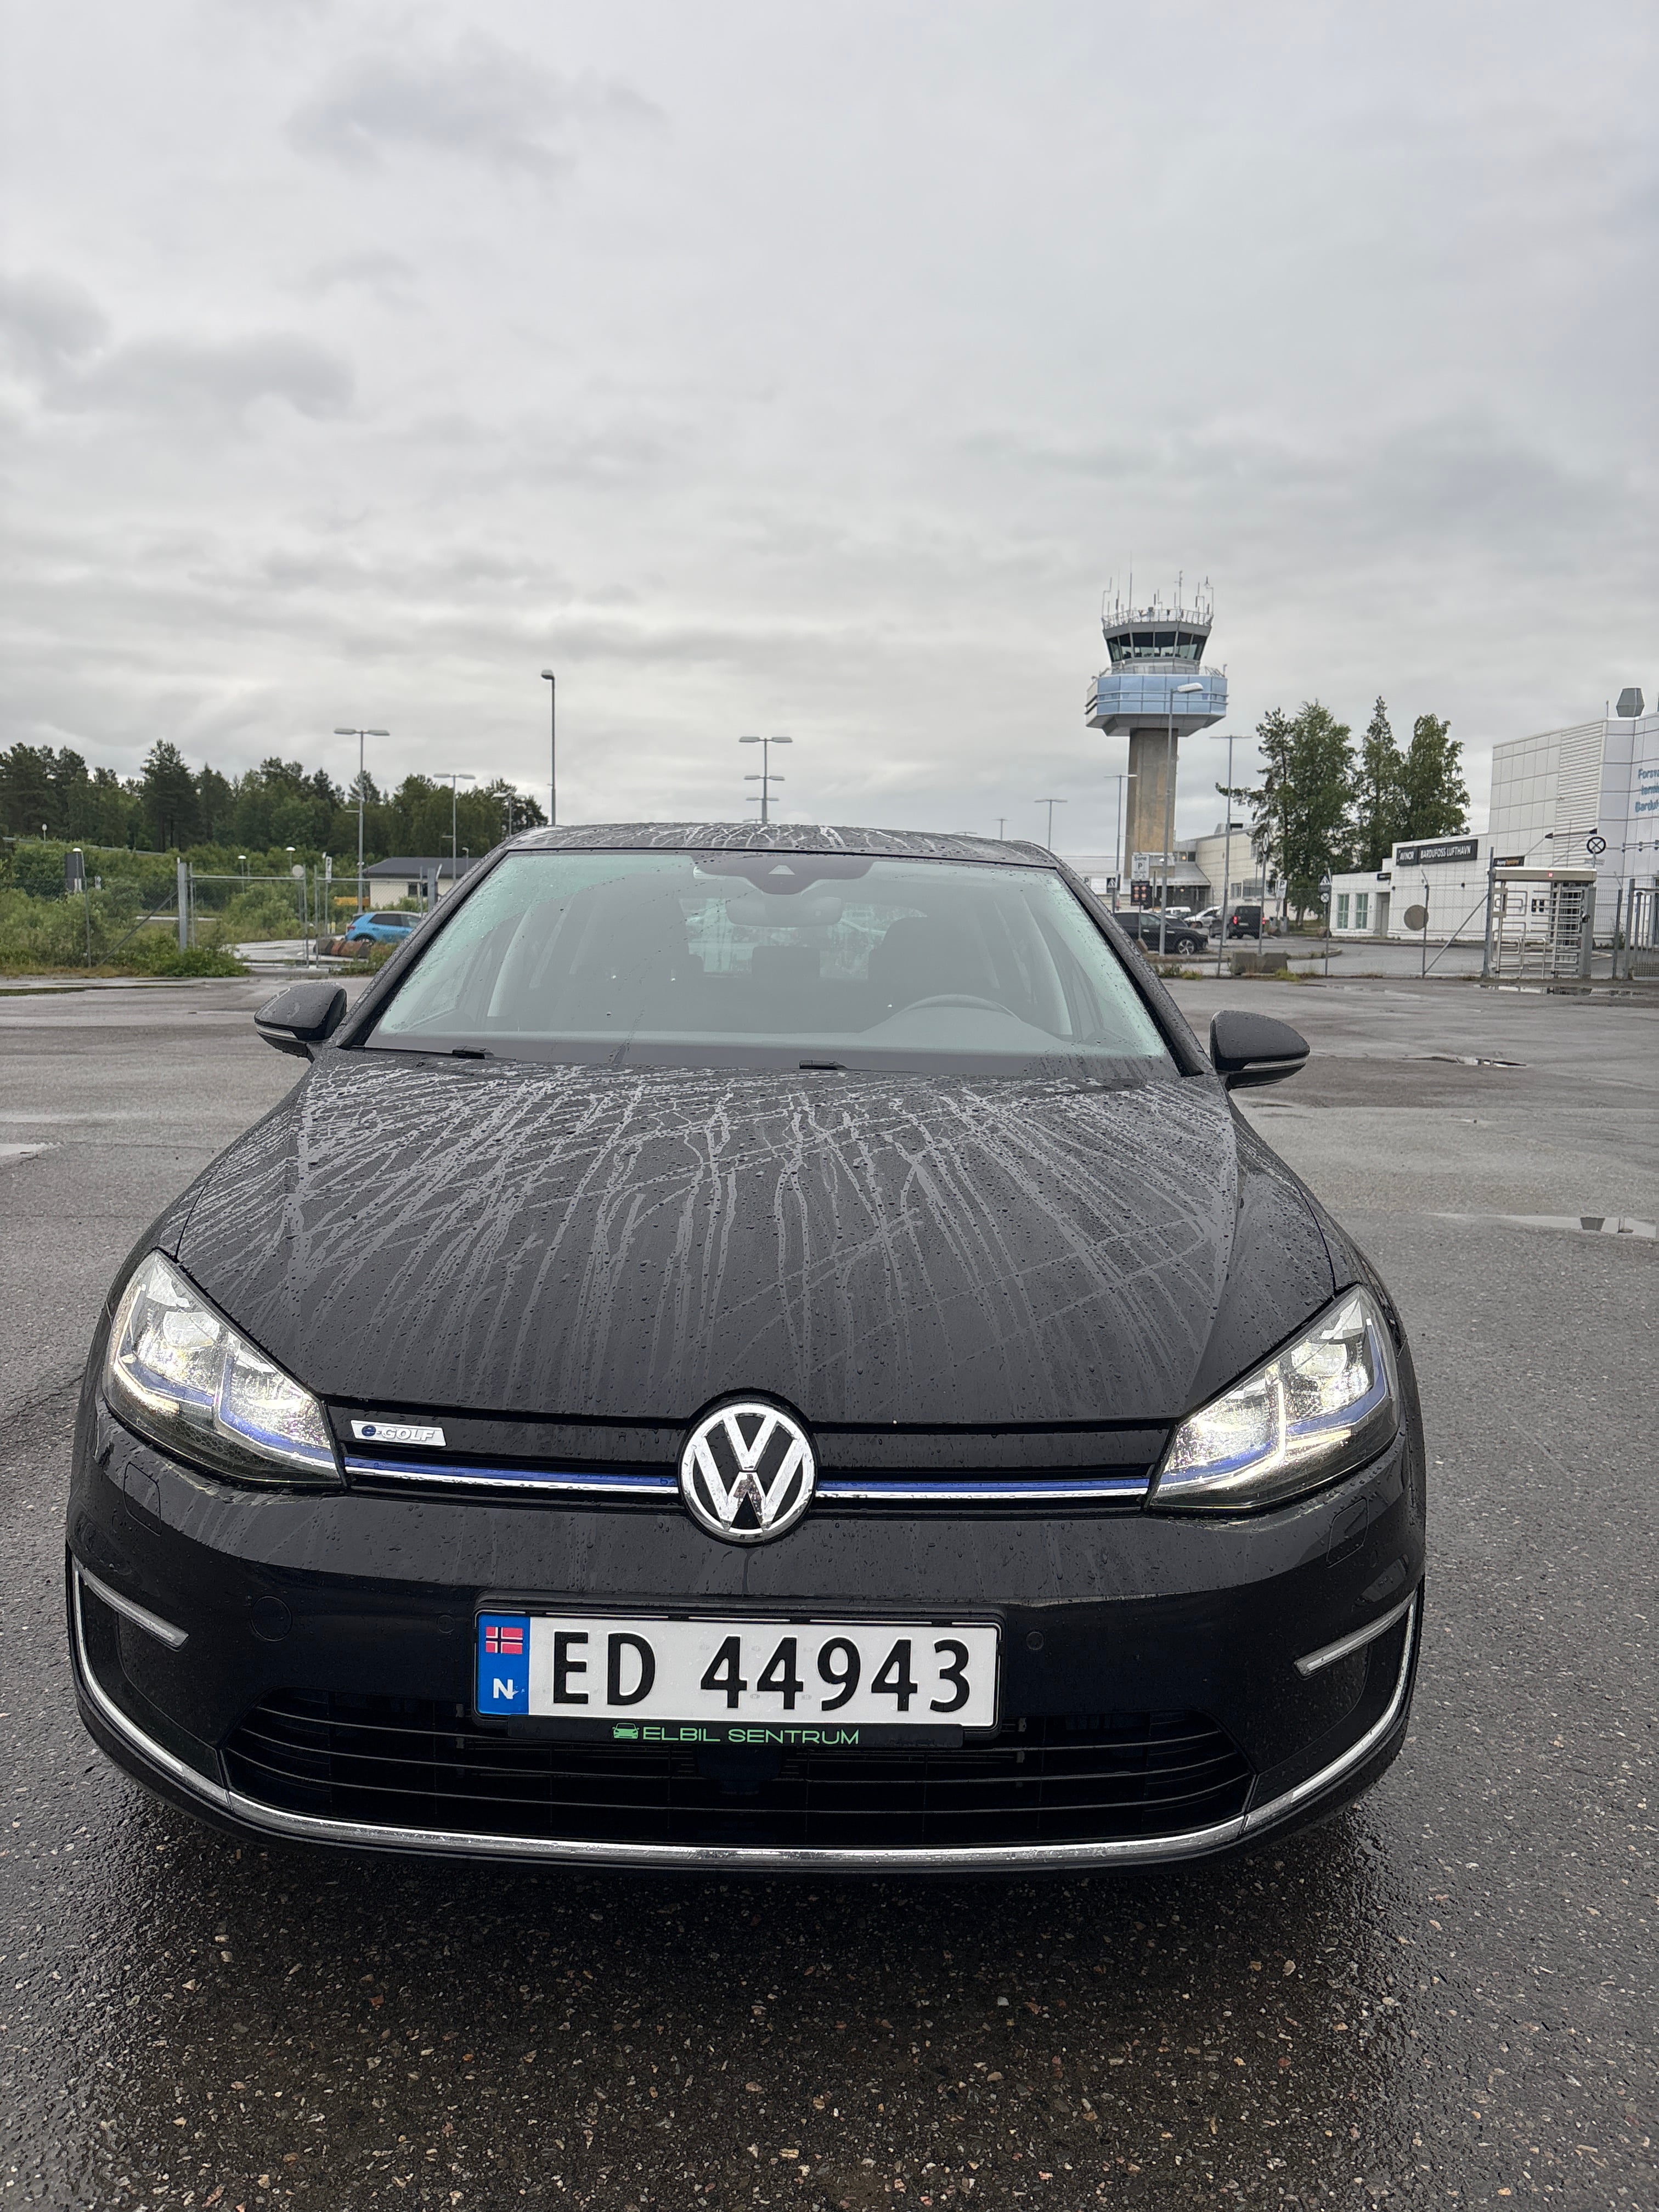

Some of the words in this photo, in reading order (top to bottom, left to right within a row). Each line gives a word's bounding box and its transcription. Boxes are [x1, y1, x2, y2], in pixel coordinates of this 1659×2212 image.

[1400, 851, 1414, 861] AVINOR
[1420, 848, 1446, 860] BARDUFOSS
[1447, 845, 1471, 857] LUFTHAVN
[362, 1425, 435, 1442] e-GOLF
[552, 1631, 657, 1706] ED
[700, 1636, 971, 1713] 44943
[493, 1678, 514, 1700] N
[643, 1727, 721, 1742] ELBIL
[728, 1728, 859, 1745] SENTRUM
